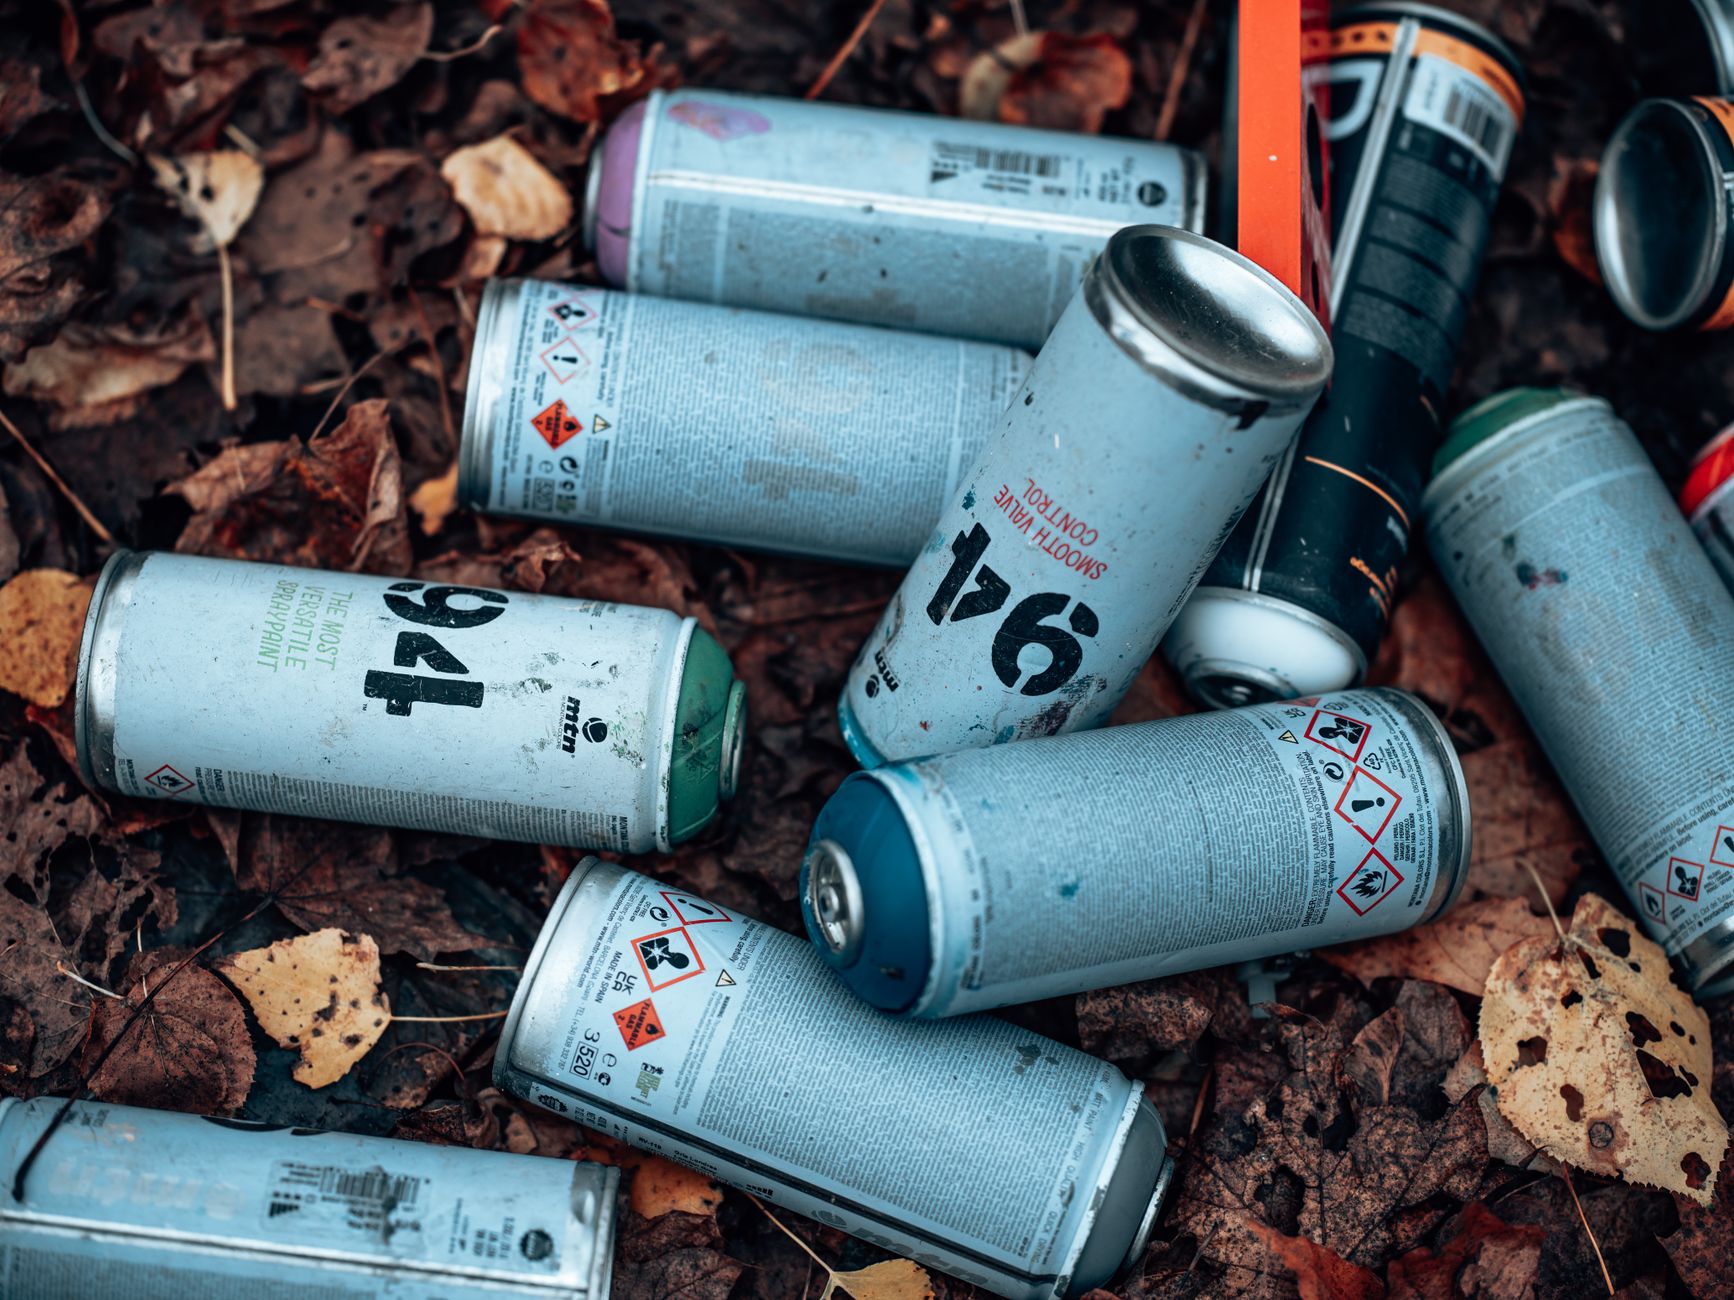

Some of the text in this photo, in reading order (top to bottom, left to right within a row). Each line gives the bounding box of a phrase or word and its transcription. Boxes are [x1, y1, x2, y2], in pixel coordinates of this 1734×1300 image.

[1021, 477, 1099, 547] CONTROL
[993, 483, 1108, 580] SMOOTH VALVE
[926, 522, 1099, 697] 94
[254, 579, 298, 673] SPRAYPAINT
[282, 585, 322, 671] VERSATILE
[313, 591, 352, 670] THE MOST
[364, 582, 507, 717] 94
[874, 650, 898, 692] mtn
[562, 696, 580, 753] mtn
[1388, 759, 1397, 769] CFC
[1405, 759, 1413, 771] Sant
[1311, 786, 1319, 801] SKIN
[1315, 775, 1328, 809] elsewhere
[1410, 773, 1418, 792] 08295
[1314, 803, 1323, 817] AND
[1399, 729, 1432, 898] montana@montanacolors.com www.montanacolors.com
[1688, 792, 1723, 817] CONTENTS
[1317, 819, 1326, 832] EYE
[1676, 817, 1697, 835] Before
[1697, 807, 1717, 824] using,
[1298, 777, 1321, 926] DANGER: EXTREMELY FLAMMABLE. CONTENTS
[1319, 834, 1327, 856] CAUSE
[1327, 860, 1336, 888] carefully
[1415, 859, 1424, 883] COLORS
[1407, 882, 1419, 906] MONTANA
[575, 925, 609, 988] www.mtn-world.com
[589, 944, 611, 981] BARCELONA
[728, 940, 745, 963] carefully
[593, 949, 623, 1004] MADE IN SPAIN
[609, 969, 629, 993] CA
[619, 973, 638, 996] UK
[617, 1013, 625, 1021] 2
[625, 1013, 637, 1029] GAS
[627, 1002, 649, 1047] FLAMMABLE
[560, 1047, 570, 1059] 332
[564, 1035, 574, 1048] 938
[557, 1058, 566, 1070] 787
[572, 1044, 595, 1076] 520
[1082, 1108, 1097, 1130] PAINT
[1070, 1140, 1085, 1161] HIGH
[1055, 1164, 1075, 1198] QUALITY
[1041, 1209, 1057, 1235] QUICK
